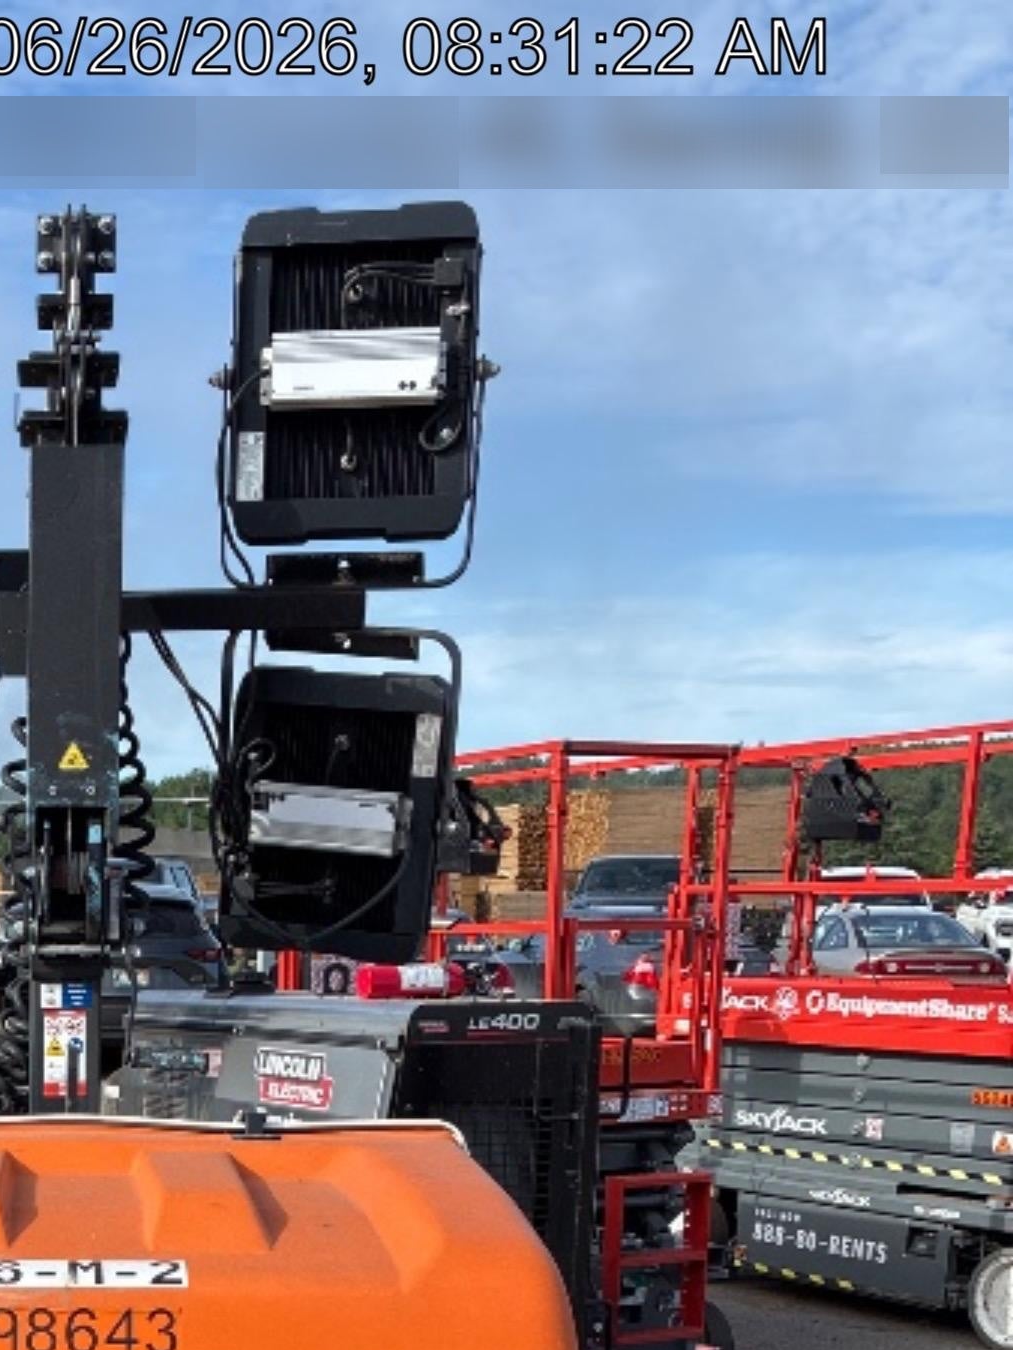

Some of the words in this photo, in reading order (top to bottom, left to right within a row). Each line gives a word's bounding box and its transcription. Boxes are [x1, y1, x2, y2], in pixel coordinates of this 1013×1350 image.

[826, 992, 988, 1020] EquipmentShare
[259, 1053, 322, 1080] LINCOLN
[734, 1106, 828, 1135] SKYJACK
